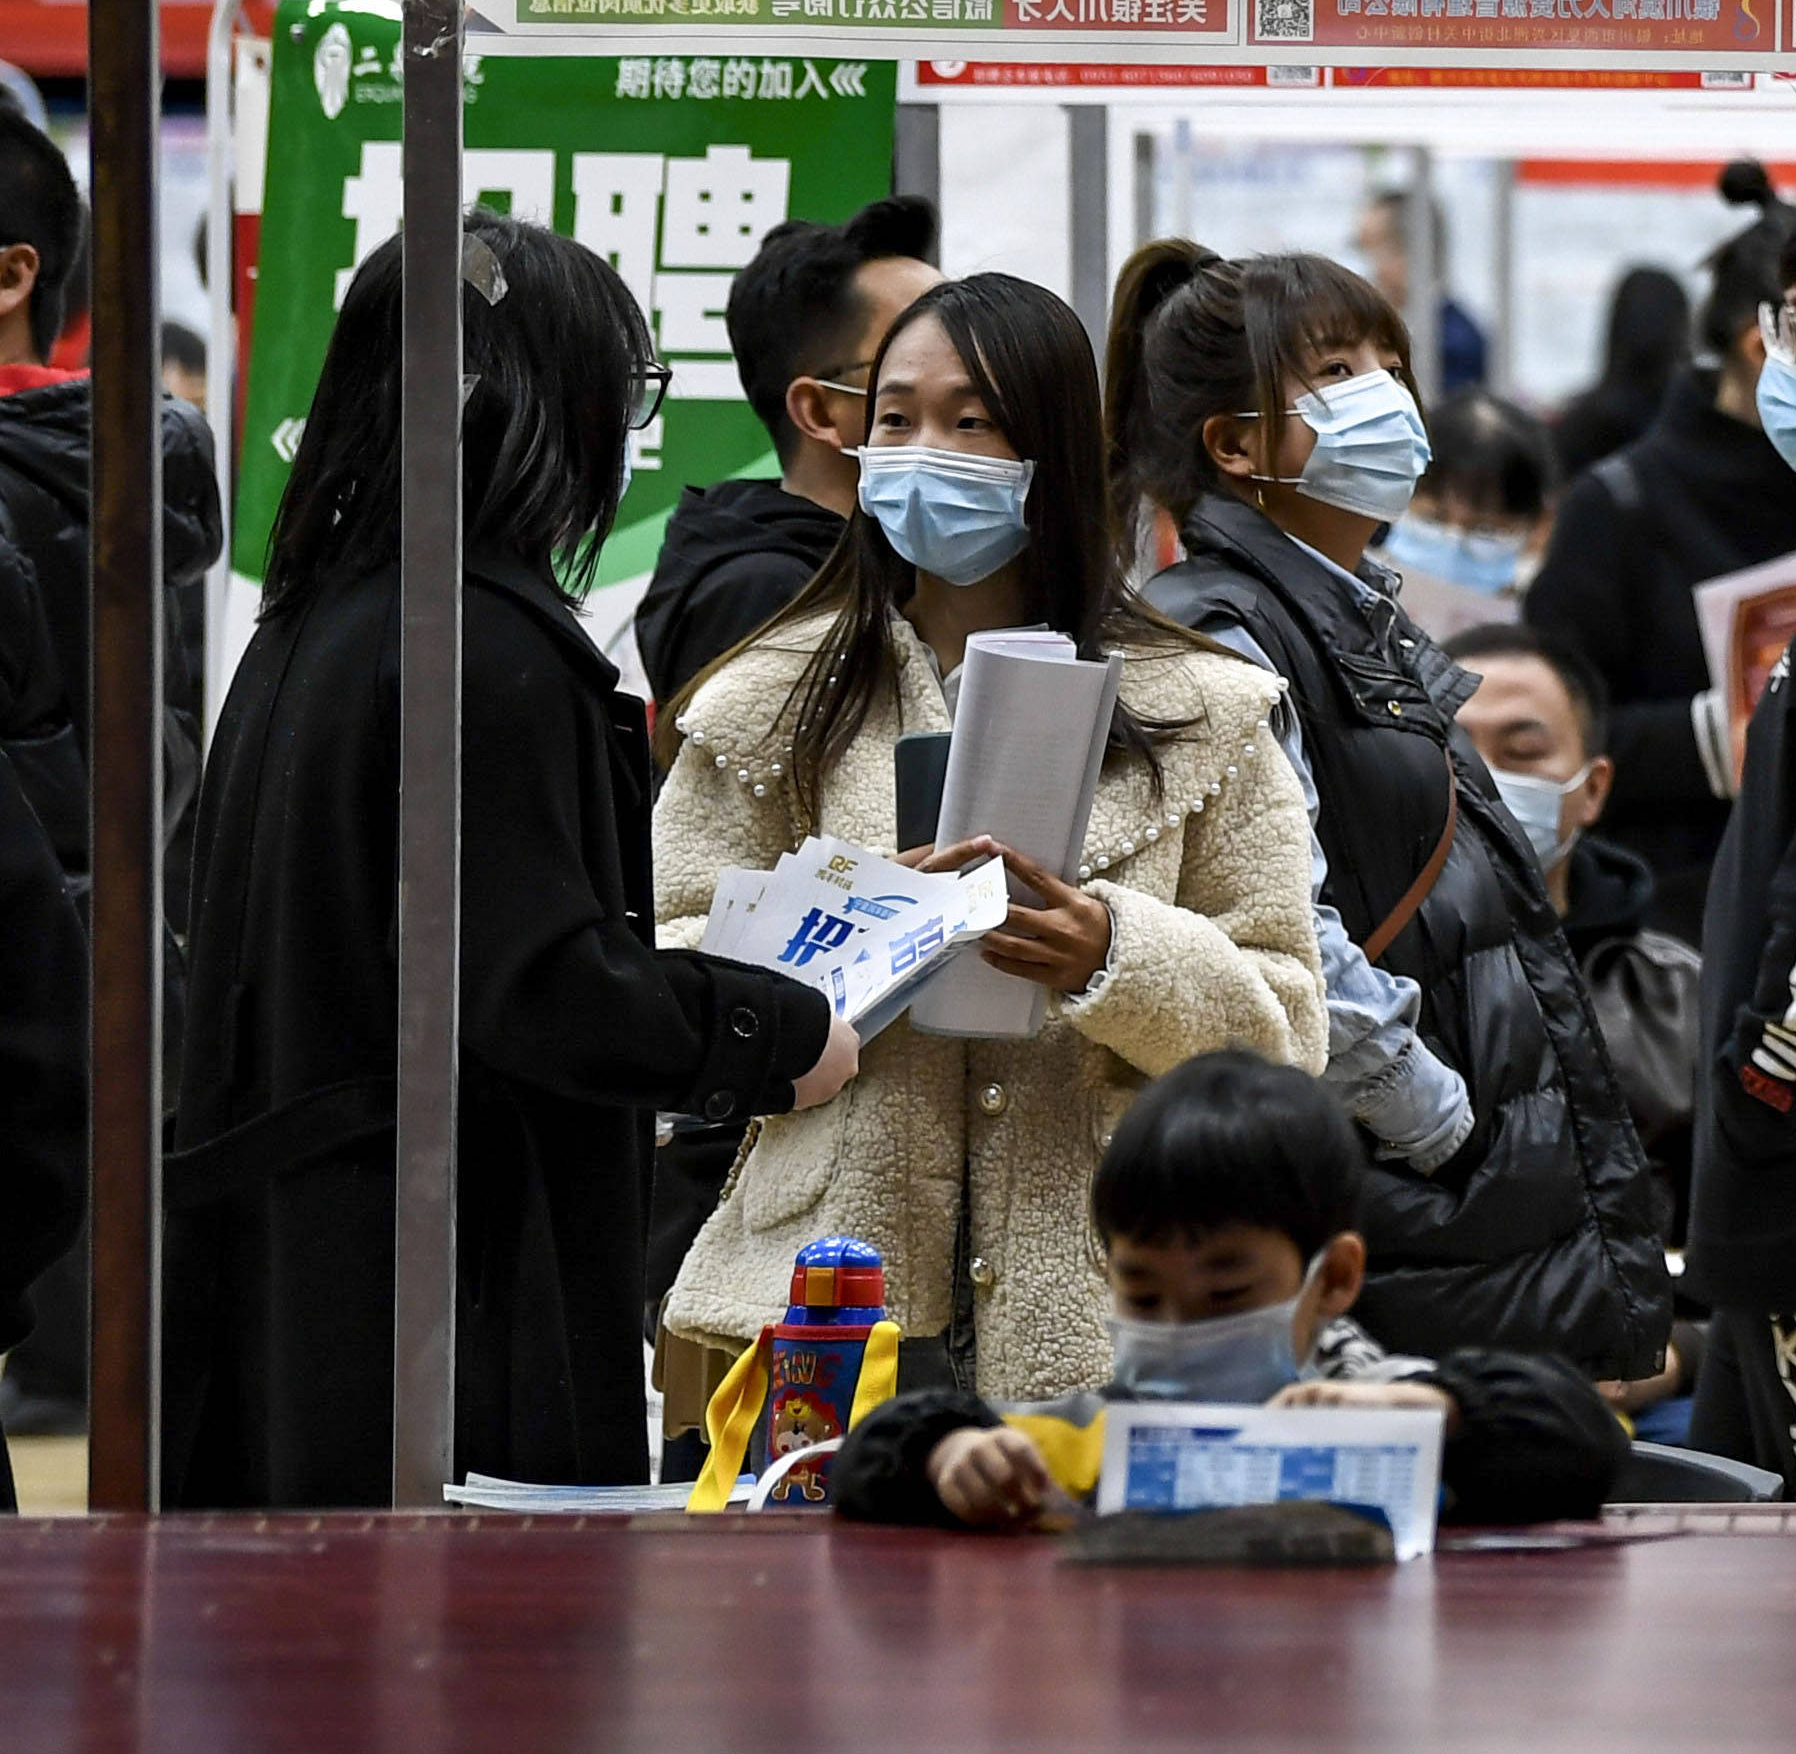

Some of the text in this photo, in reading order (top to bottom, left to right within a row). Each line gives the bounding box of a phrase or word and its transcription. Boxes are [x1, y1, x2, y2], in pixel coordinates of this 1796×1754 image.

[616, 57, 826, 101] 期待您的加入
